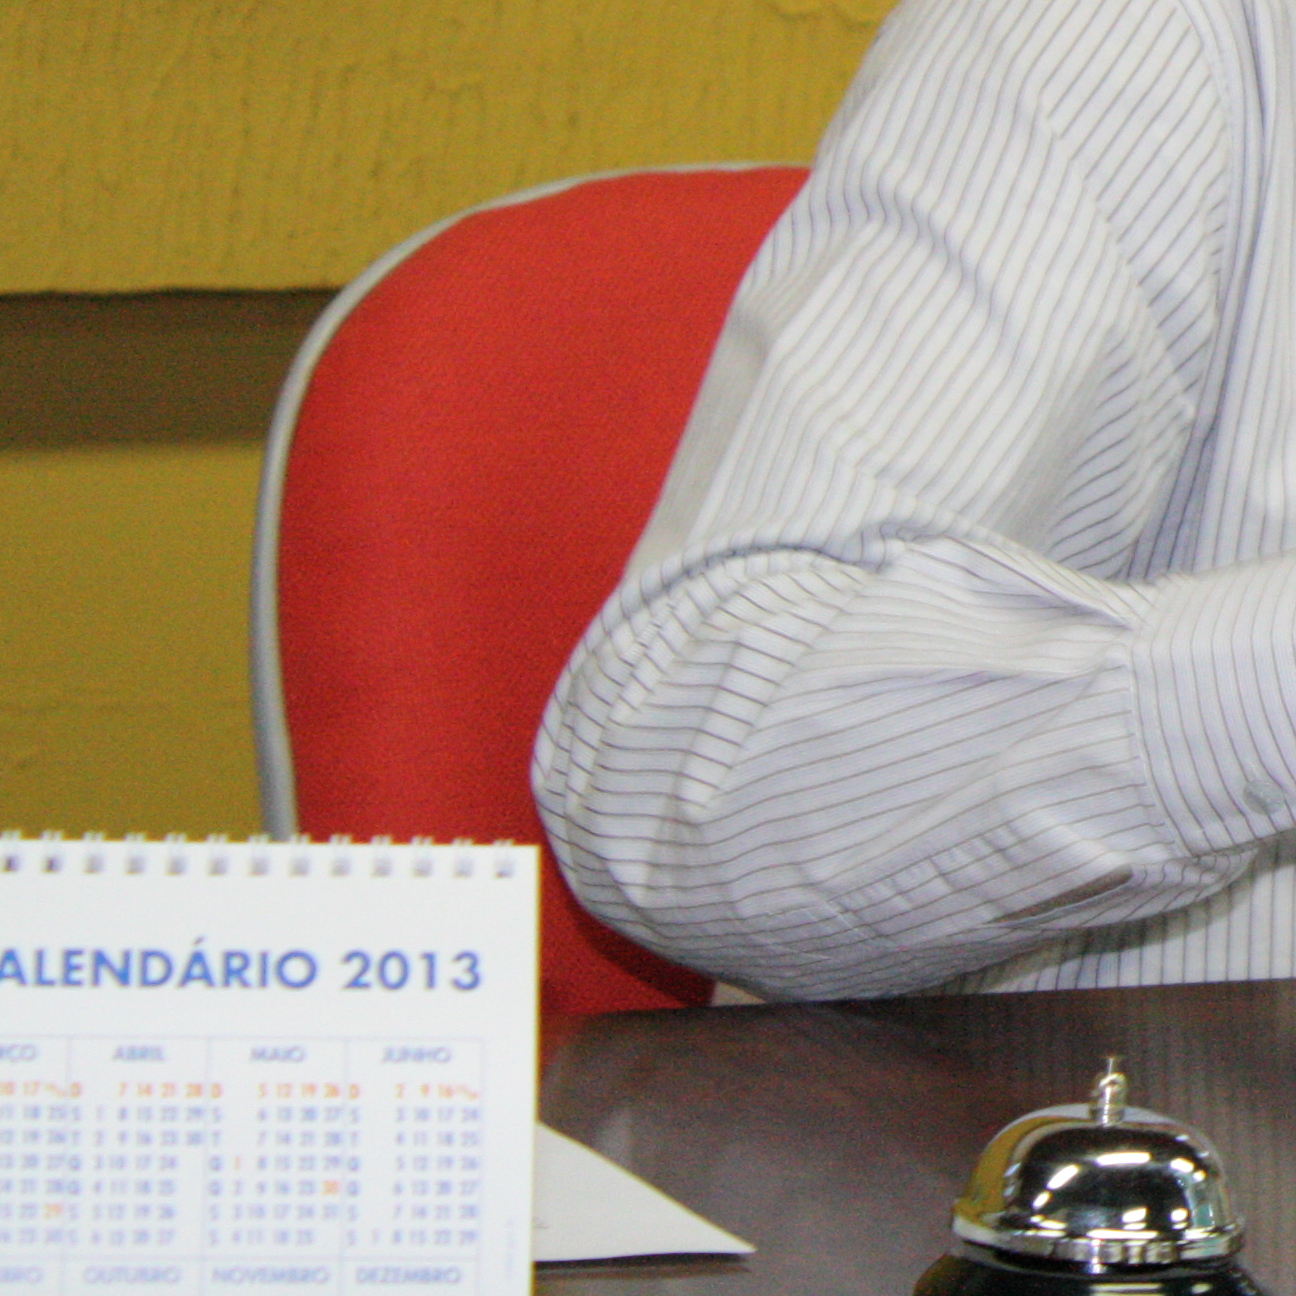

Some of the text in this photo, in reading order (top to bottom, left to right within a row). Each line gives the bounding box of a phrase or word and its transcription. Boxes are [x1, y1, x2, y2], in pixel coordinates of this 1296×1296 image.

[0, 938, 482, 991] ALENDÁRIO 2013
[251, 1045, 306, 1063] MAIO
